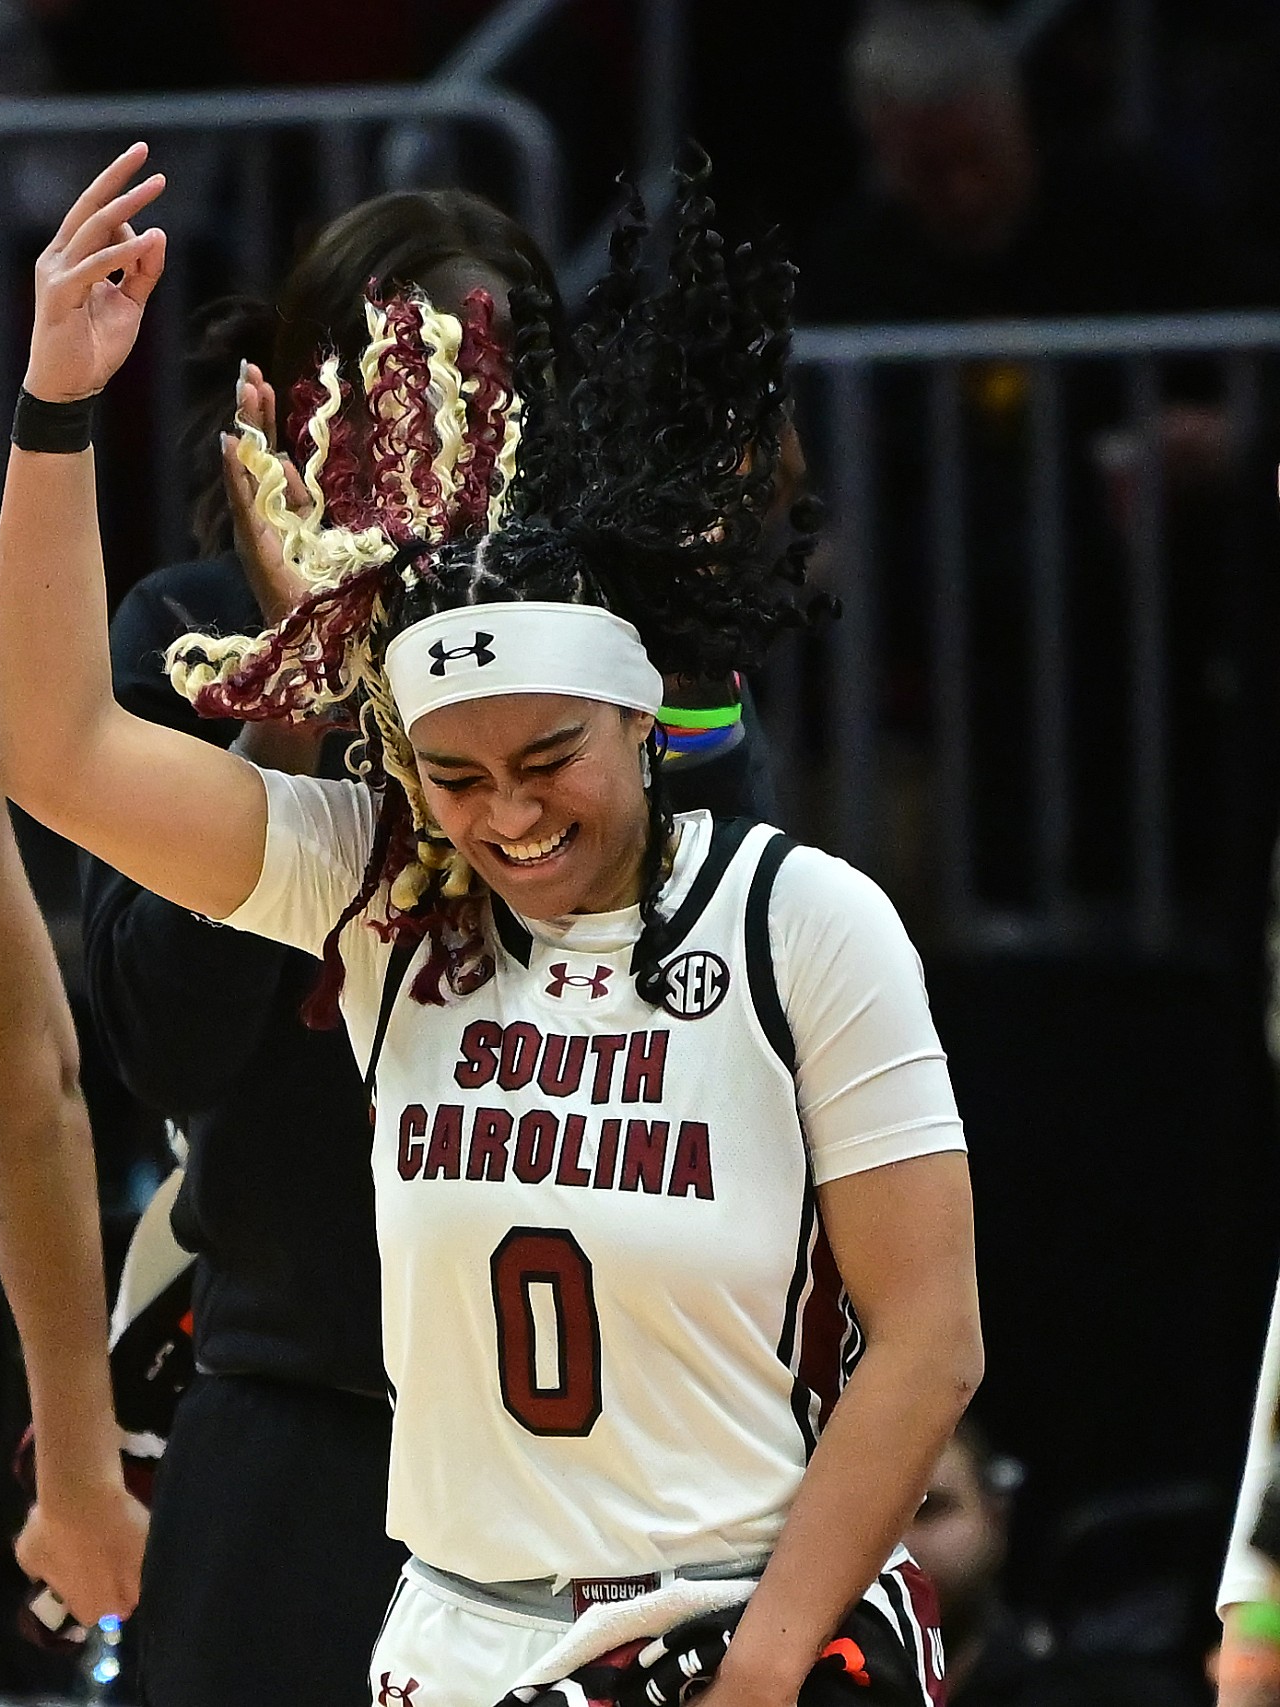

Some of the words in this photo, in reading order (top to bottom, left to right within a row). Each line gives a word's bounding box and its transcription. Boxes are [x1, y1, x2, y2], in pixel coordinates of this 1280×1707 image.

[665, 954, 723, 1014] SEC
[453, 1019, 671, 1105] SOUTH
[396, 1103, 716, 1201] CAROLINA
[489, 1225, 604, 1438] 0
[581, 1583, 646, 1600] CAROLINA
